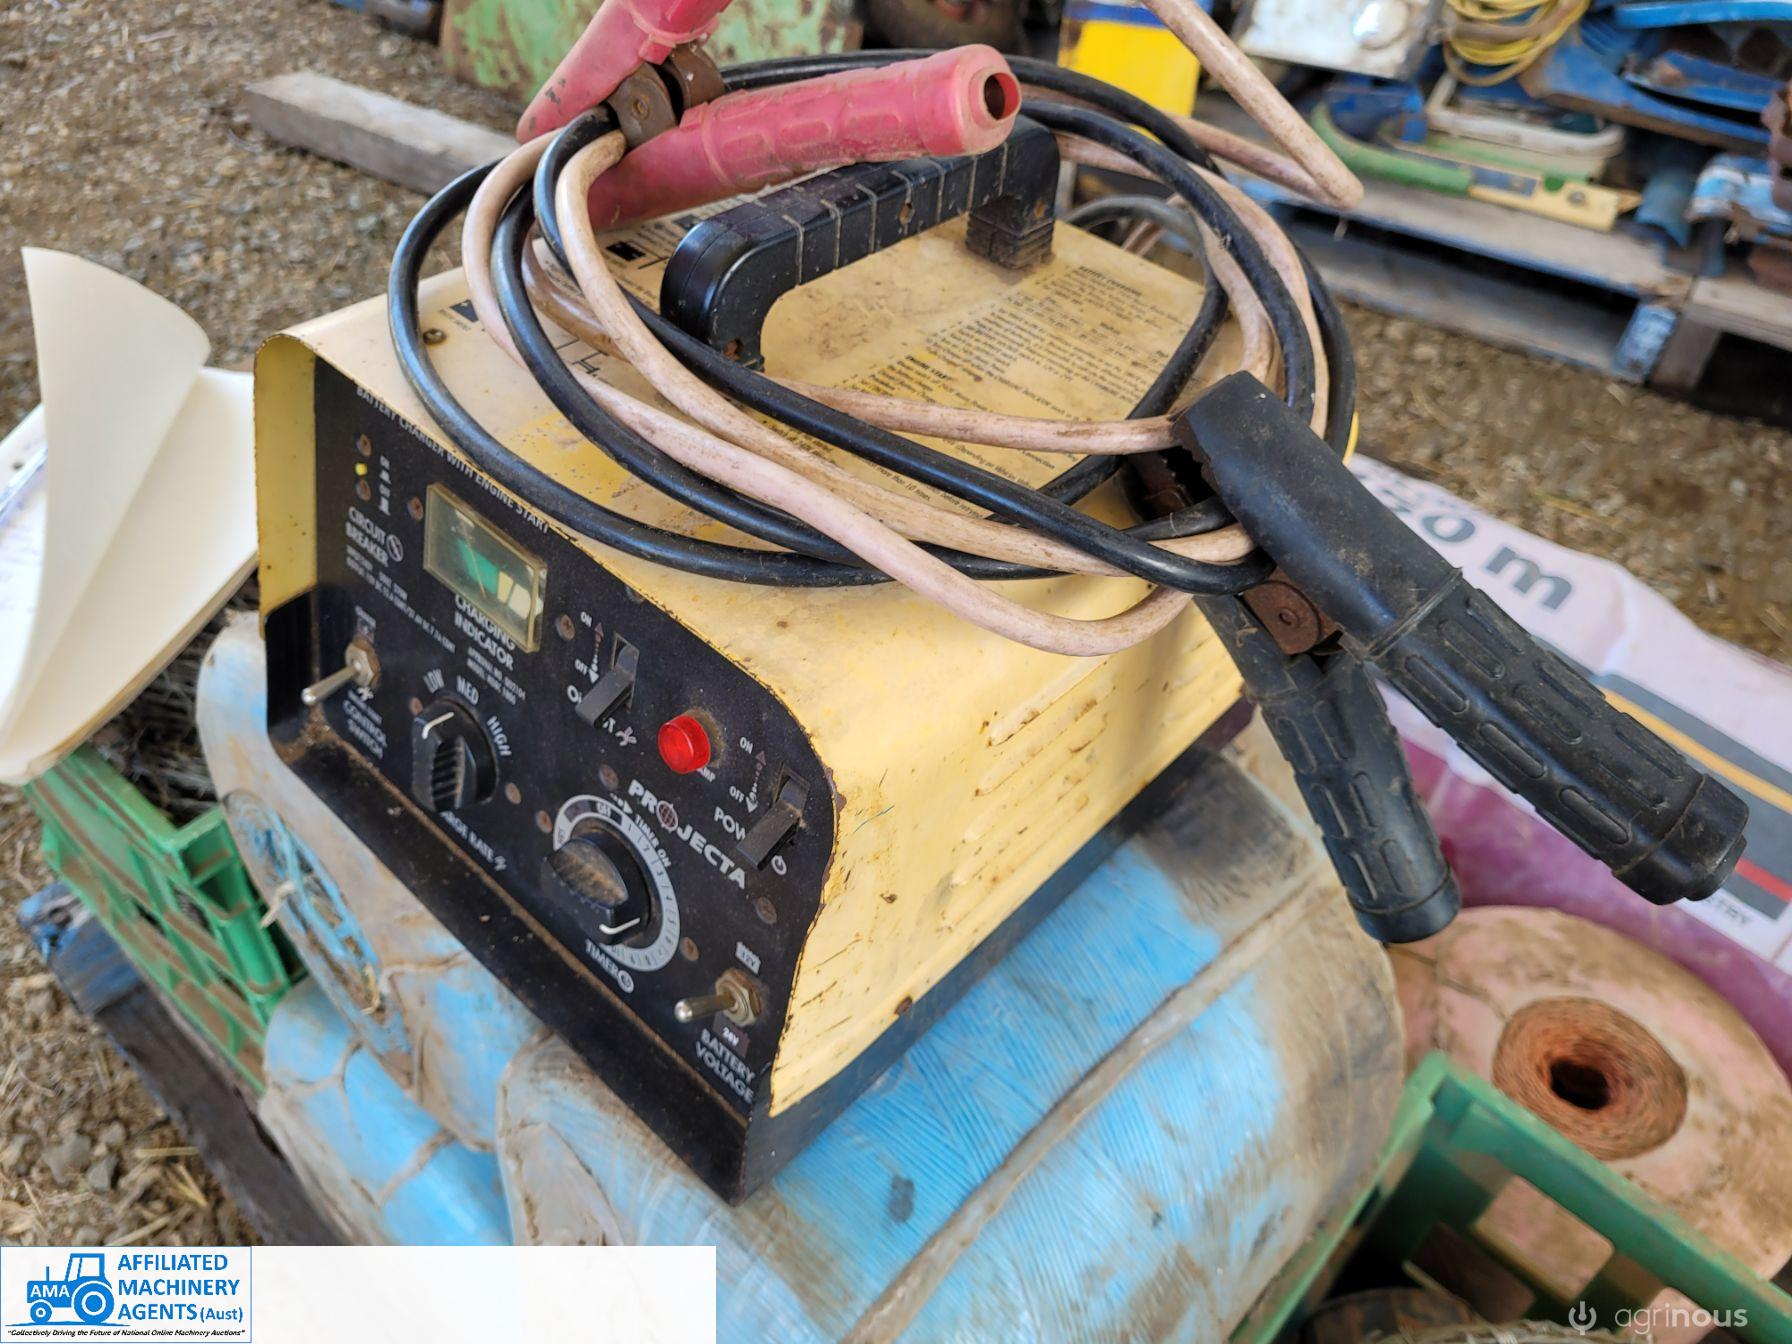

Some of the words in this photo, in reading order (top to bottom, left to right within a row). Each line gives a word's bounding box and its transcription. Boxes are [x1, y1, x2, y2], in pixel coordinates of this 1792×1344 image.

[356, 386, 398, 422] BATTERY
[399, 417, 446, 458] CHARGER
[446, 449, 474, 480] WITH
[474, 471, 515, 509] ENGINE
[515, 503, 550, 534] START
[345, 521, 389, 568] BREAKER
[348, 506, 387, 545] CIRCUIT
[454, 611, 514, 671] INDICATOR
[580, 611, 593, 628] ON
[456, 675, 479, 706] MED
[486, 715, 513, 757] HIGH
[739, 736, 754, 755] ON
[728, 785, 746, 803] OFF
[628, 779, 746, 889] PROJECTA
[585, 938, 619, 981] TIMER
[696, 1040, 755, 1104] VOLTAGE
[701, 1028, 756, 1083] BATTERY
